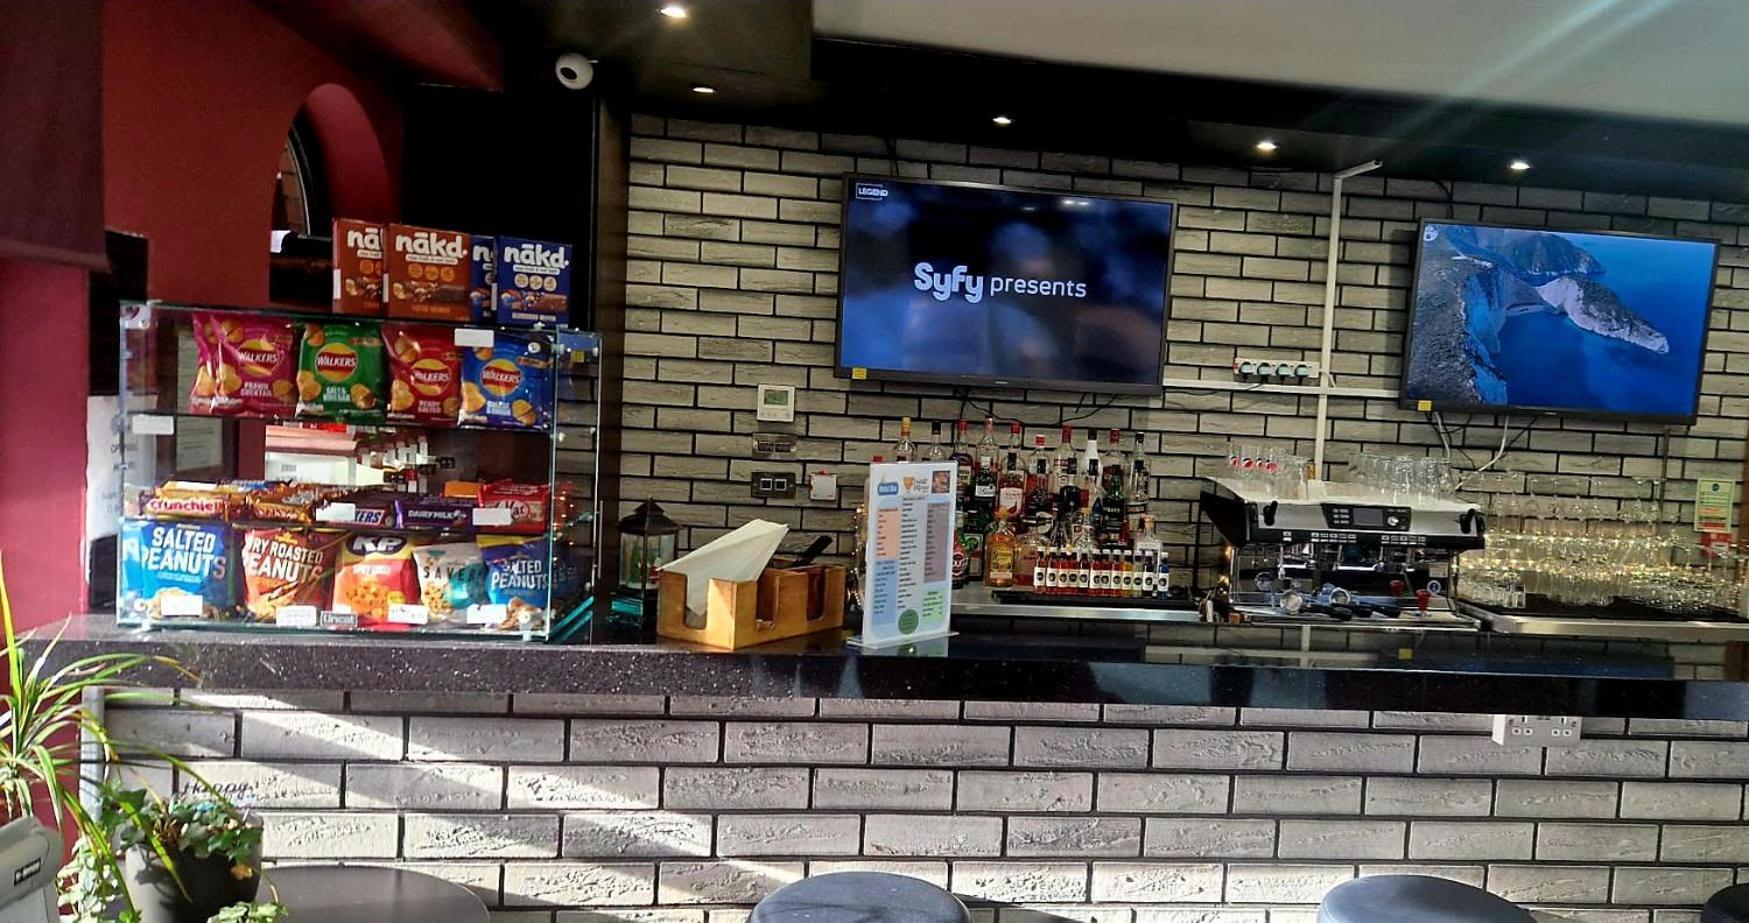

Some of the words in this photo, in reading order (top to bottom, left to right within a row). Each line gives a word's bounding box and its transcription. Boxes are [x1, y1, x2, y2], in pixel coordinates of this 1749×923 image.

[914, 262, 984, 304] Syfy
[990, 276, 1087, 298] presents
[239, 351, 278, 363] WALKERS
[317, 355, 356, 367] WALKERS
[414, 370, 450, 382] WALKERS
[482, 370, 519, 383] WALKERS
[152, 526, 217, 554] SALTED
[353, 535, 402, 552] KP
[270, 541, 324, 565] ROASTED
[141, 546, 227, 579] PEANUTS
[503, 559, 542, 575] SALTED
[491, 571, 548, 592] PEANUTS
